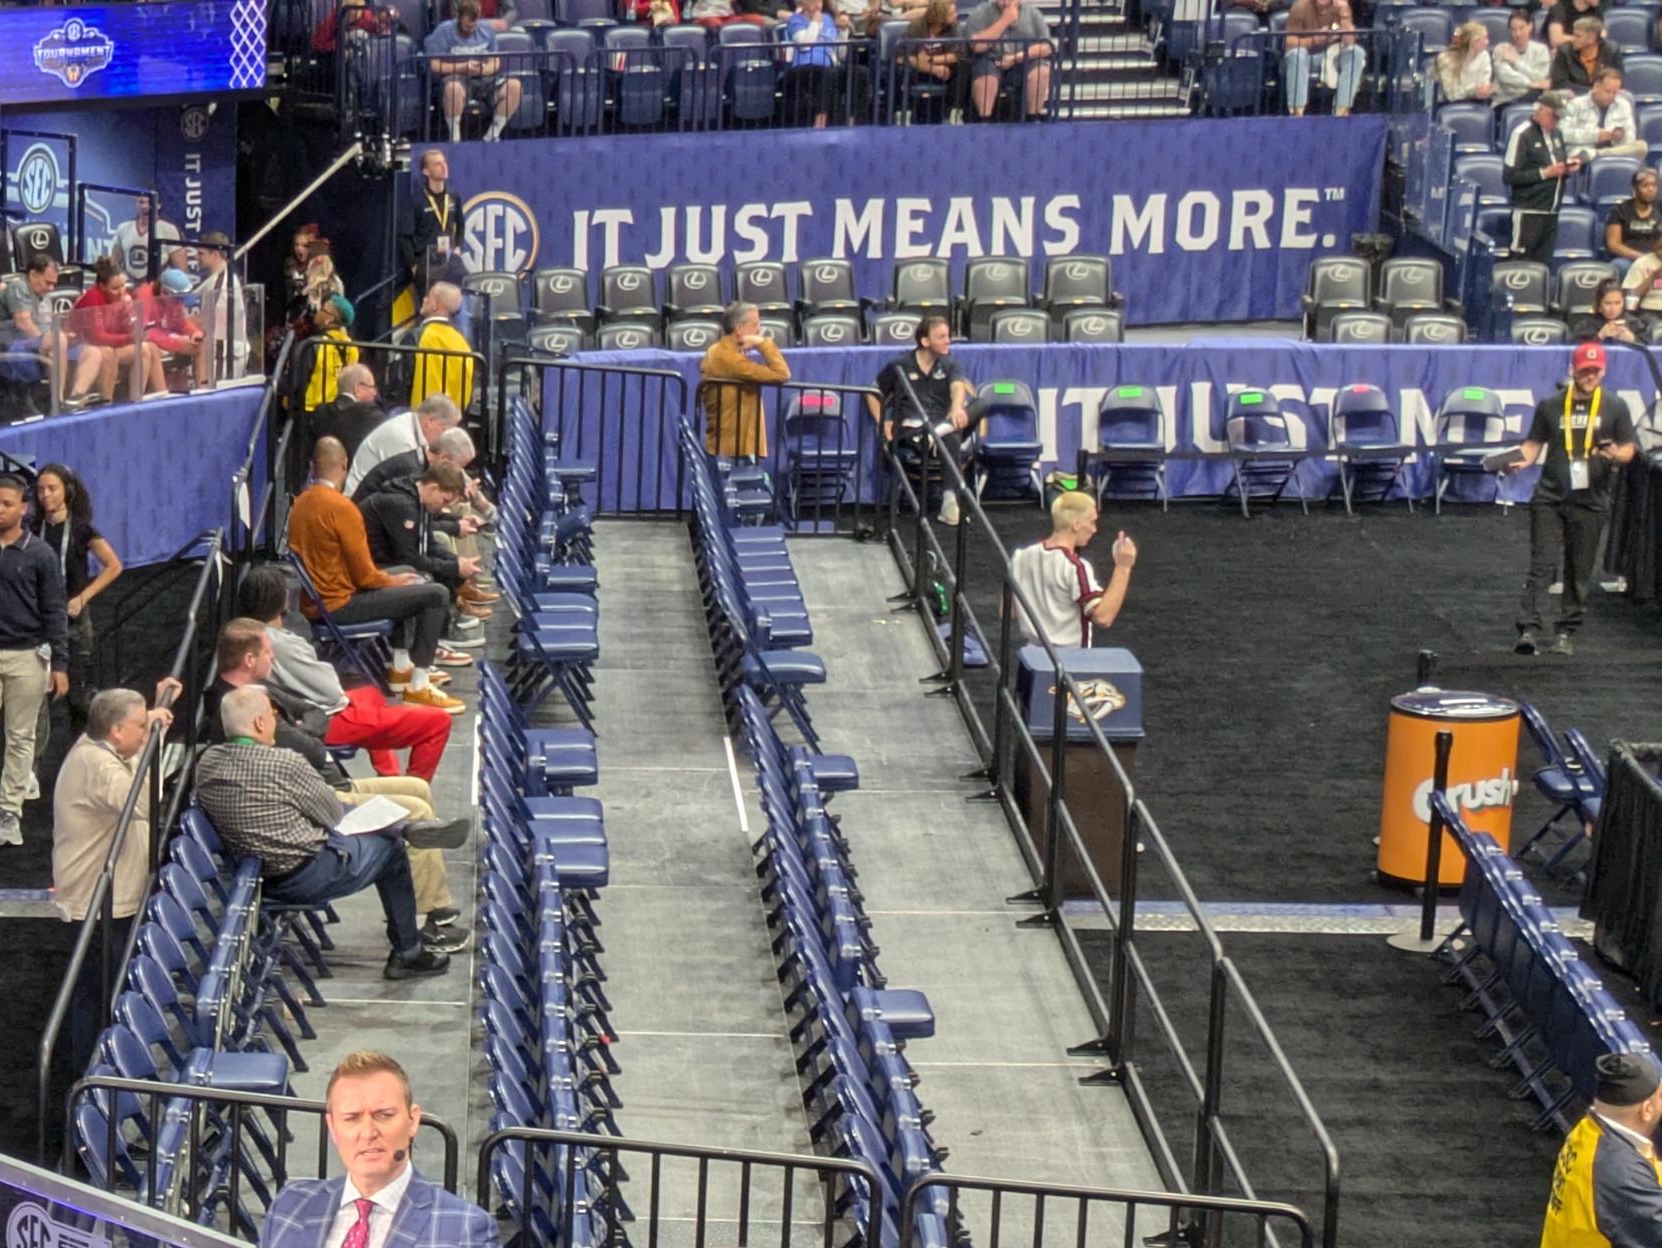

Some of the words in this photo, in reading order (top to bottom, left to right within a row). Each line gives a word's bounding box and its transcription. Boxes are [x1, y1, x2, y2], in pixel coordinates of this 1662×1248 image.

[36, 45, 111, 59] TOURNAMENT
[24, 158, 52, 208] SEC
[185, 154, 201, 173] IT
[184, 177, 202, 232] JUST
[460, 203, 527, 273] SEC
[572, 208, 635, 271] IT
[644, 201, 814, 270] JUST
[831, 197, 1081, 260] MEANS
